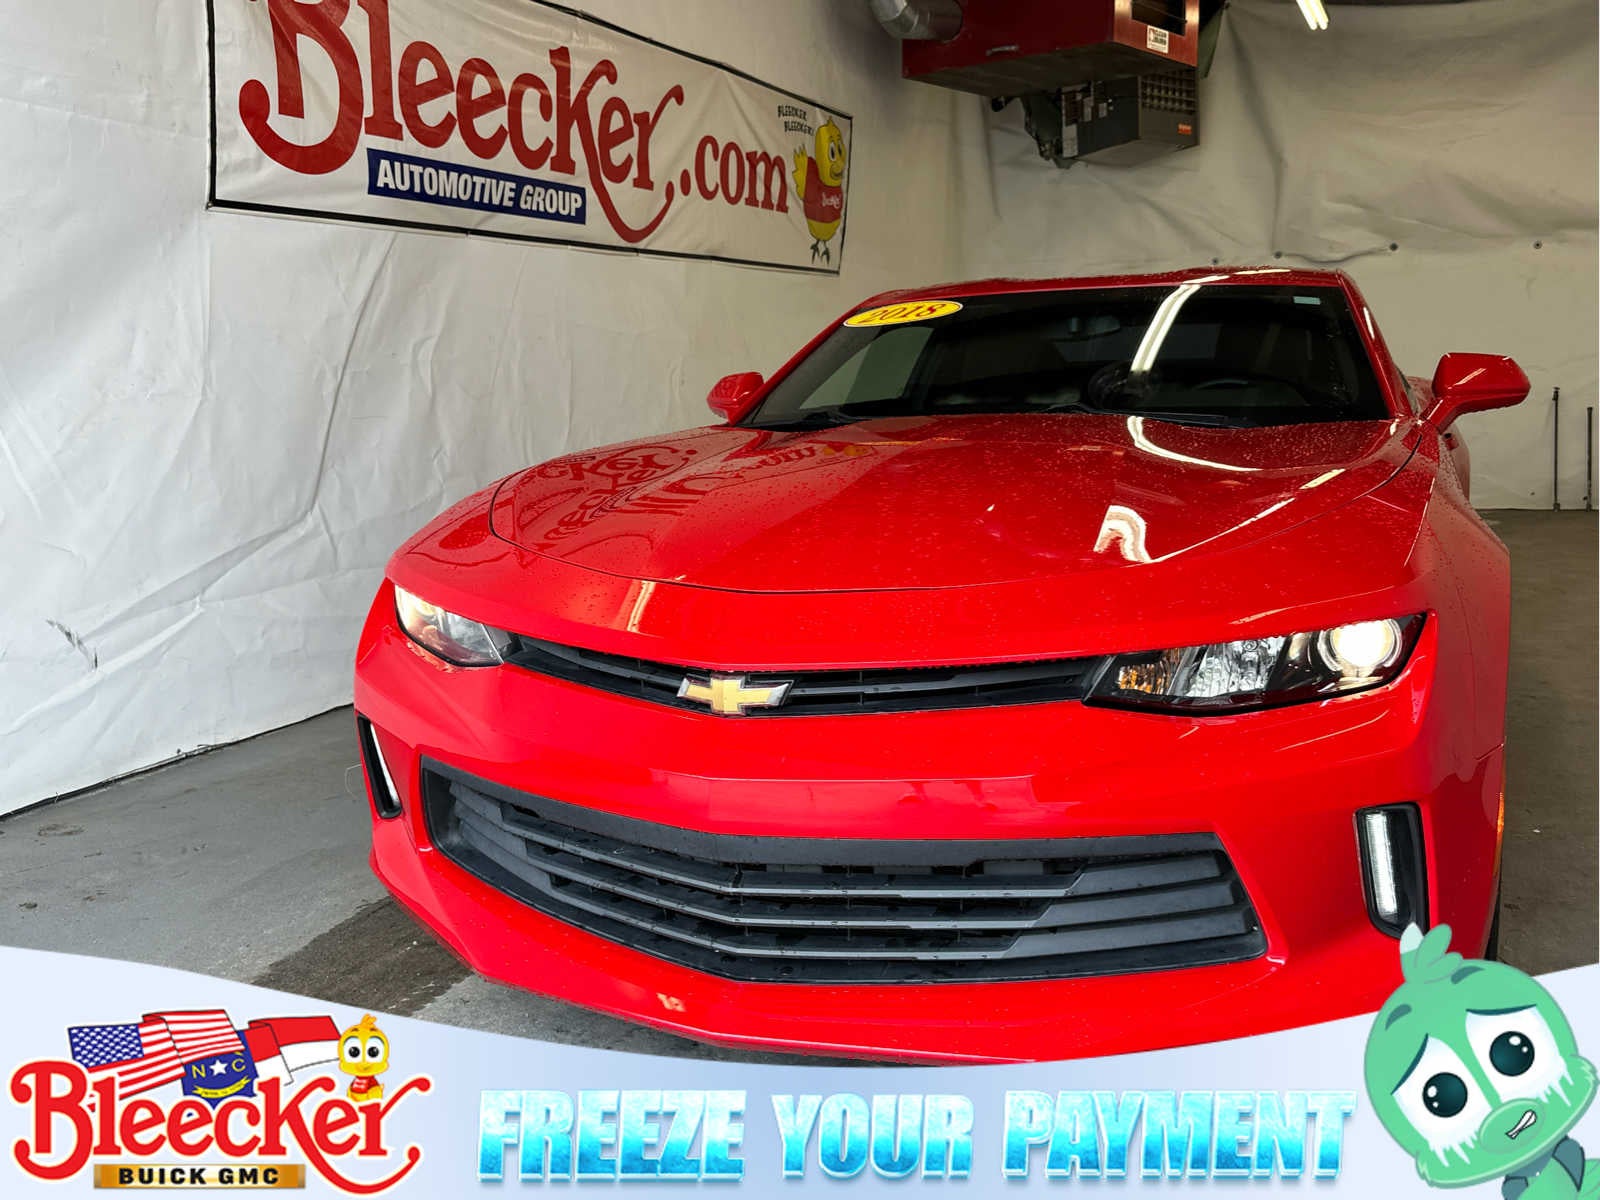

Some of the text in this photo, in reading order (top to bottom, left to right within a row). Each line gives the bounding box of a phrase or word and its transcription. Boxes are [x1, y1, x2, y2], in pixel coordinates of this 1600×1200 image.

[376, 159, 583, 217] AUTOMOTIVE GROUP
[857, 303, 947, 325] 2018
